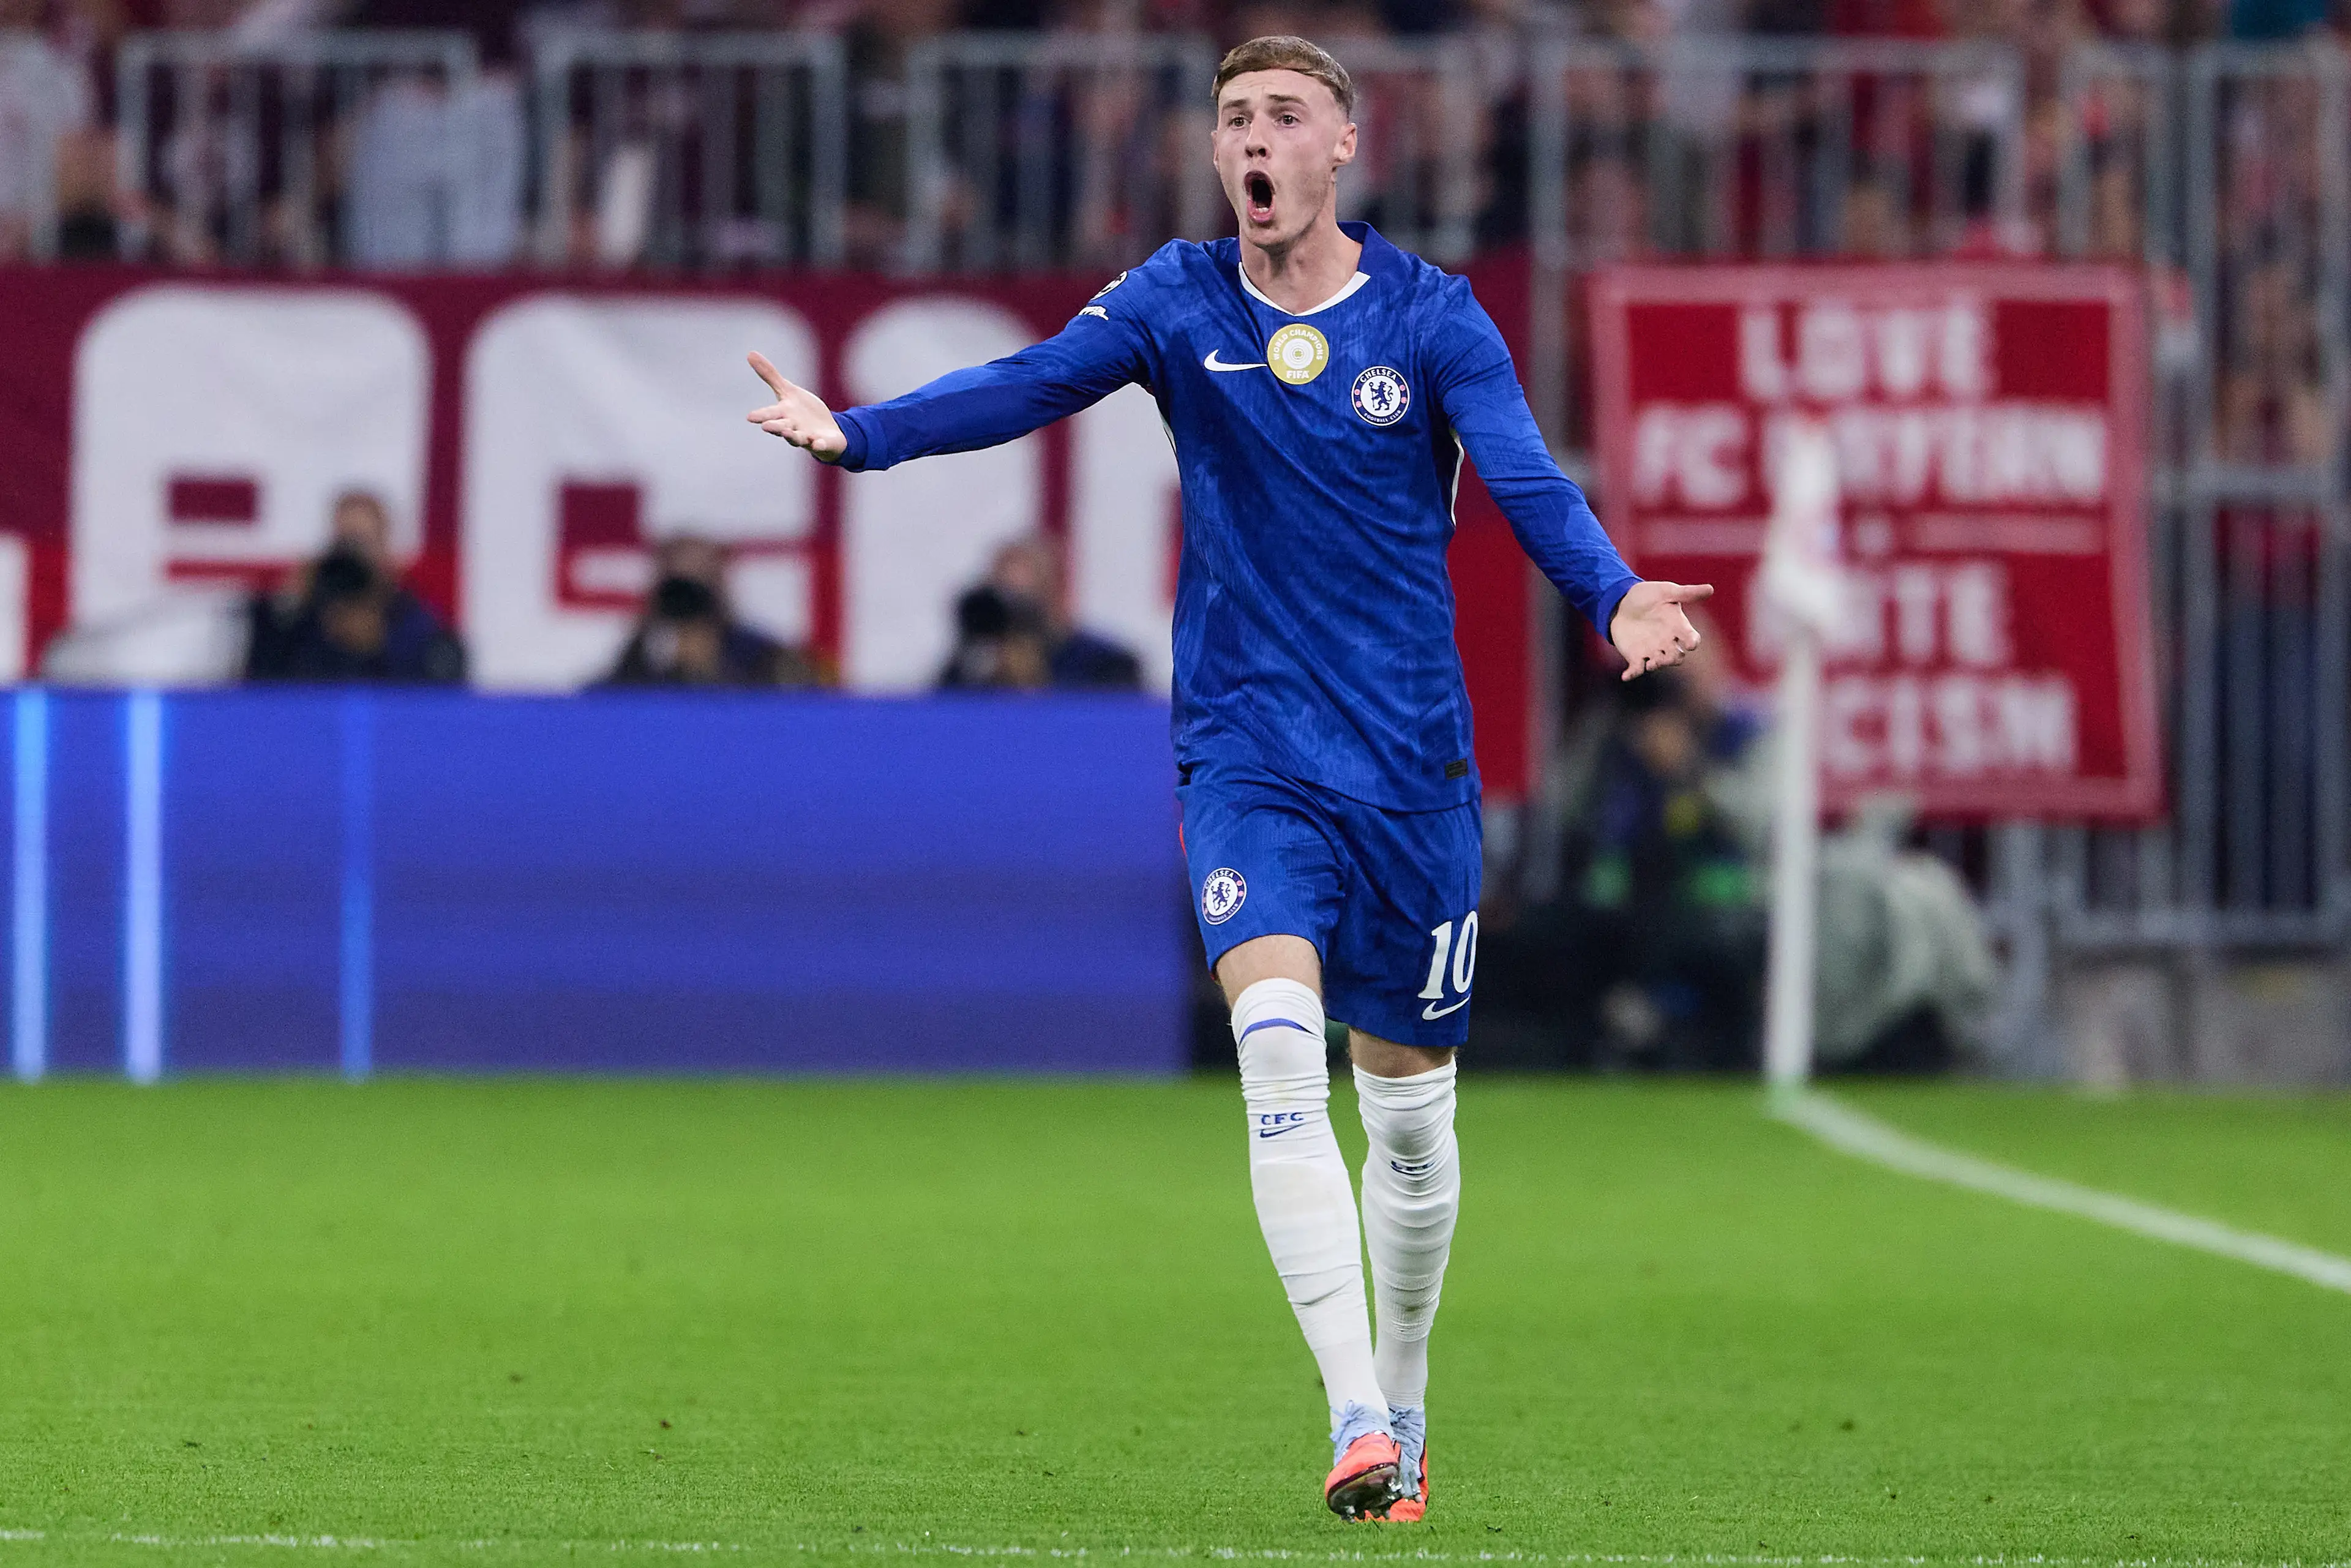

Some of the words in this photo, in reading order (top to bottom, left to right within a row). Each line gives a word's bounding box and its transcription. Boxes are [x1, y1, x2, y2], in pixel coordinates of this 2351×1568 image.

[1273, 333, 1288, 360] WORLD
[1289, 329, 1323, 360] CHAMPIONS
[1736, 301, 1993, 399] LOVE
[1286, 370, 1309, 378] FIFA
[1360, 369, 1397, 383] CHELSEA
[1364, 413, 1389, 422] FOOTBALL
[1390, 410, 1401, 420] CLUB
[1633, 407, 1747, 508] FC
[1417, 910, 1479, 999] 10
[1261, 1112, 1304, 1125] CFC
